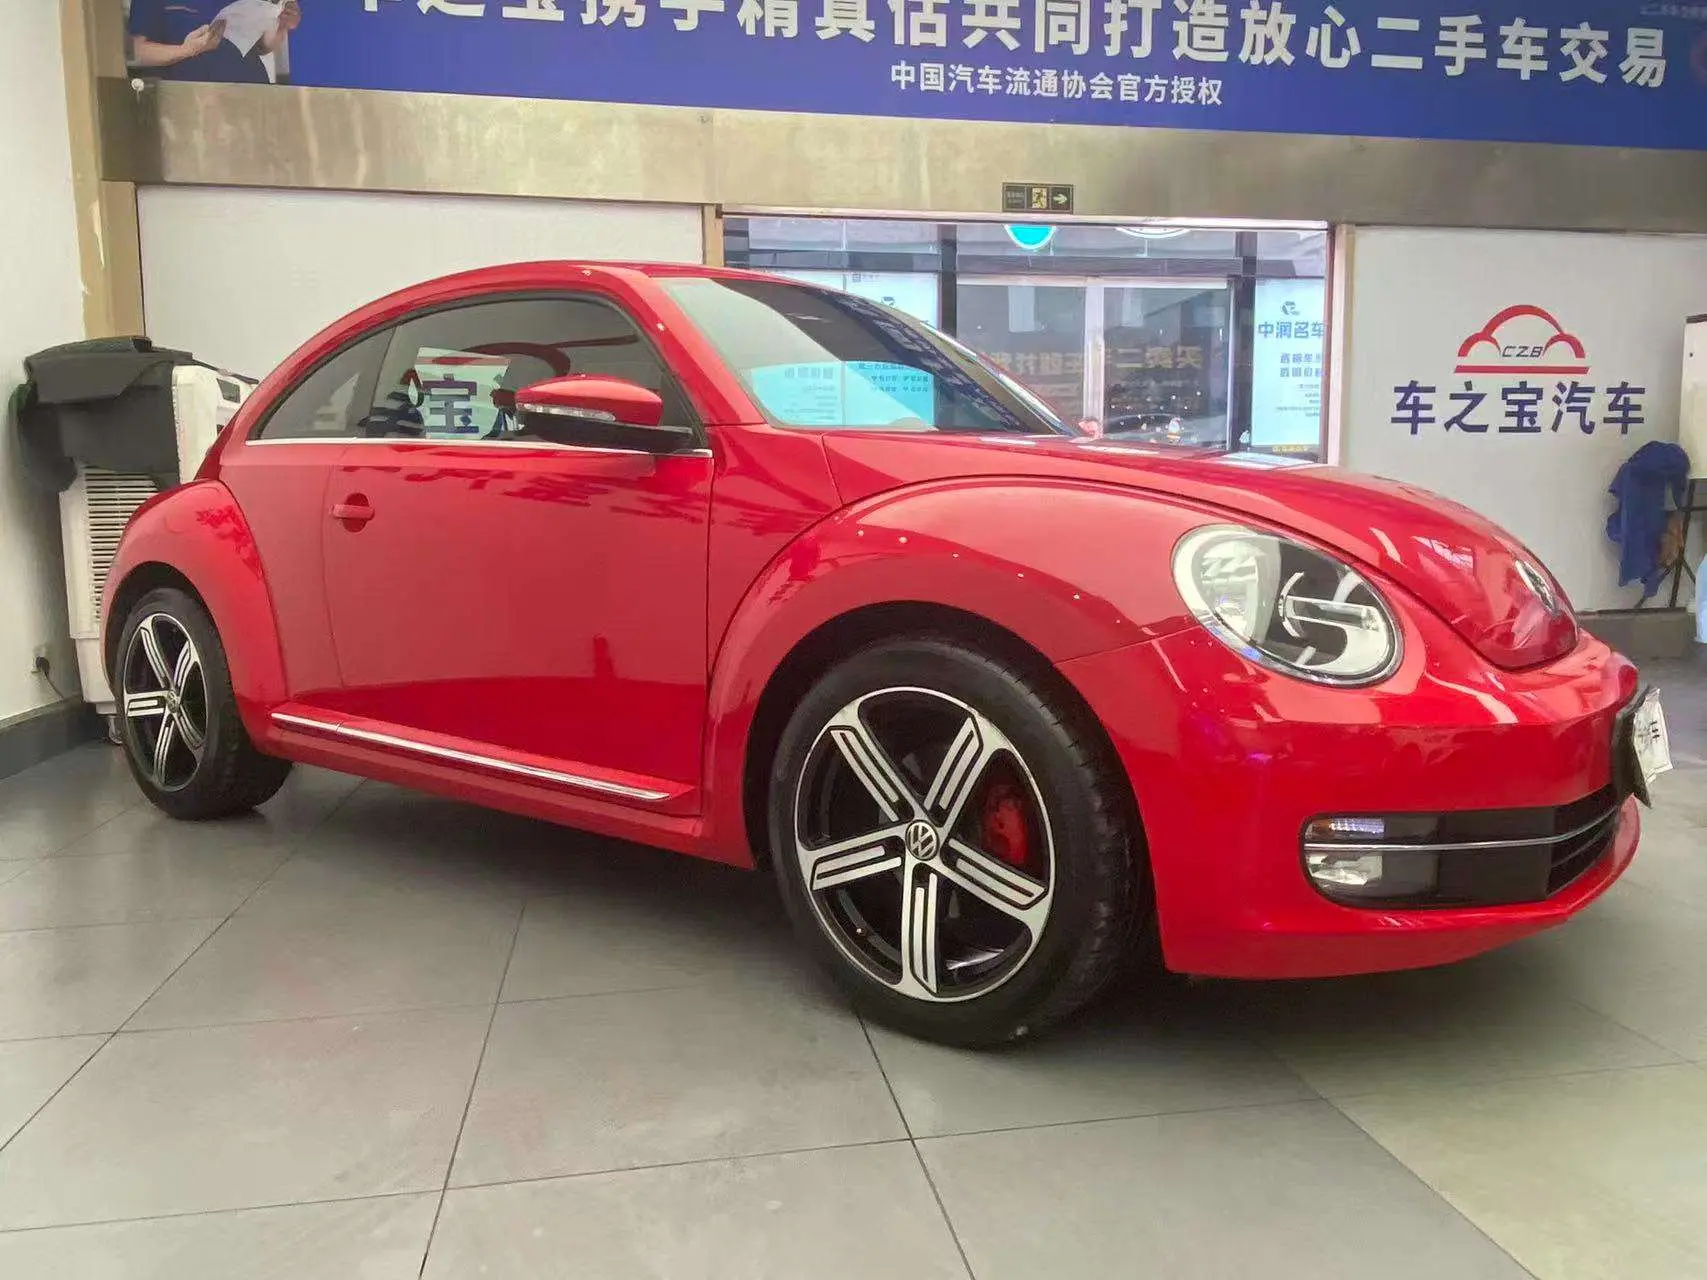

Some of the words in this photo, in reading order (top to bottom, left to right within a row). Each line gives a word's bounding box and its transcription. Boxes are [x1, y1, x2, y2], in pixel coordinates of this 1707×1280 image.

[363, 0, 1667, 88] 精真估共同打造放心二手车交易
[890, 60, 1224, 105] 中国汽车流通协会官方授权
[1502, 345, 1543, 358] CZB
[1391, 380, 1645, 434] 车之宝汽车
